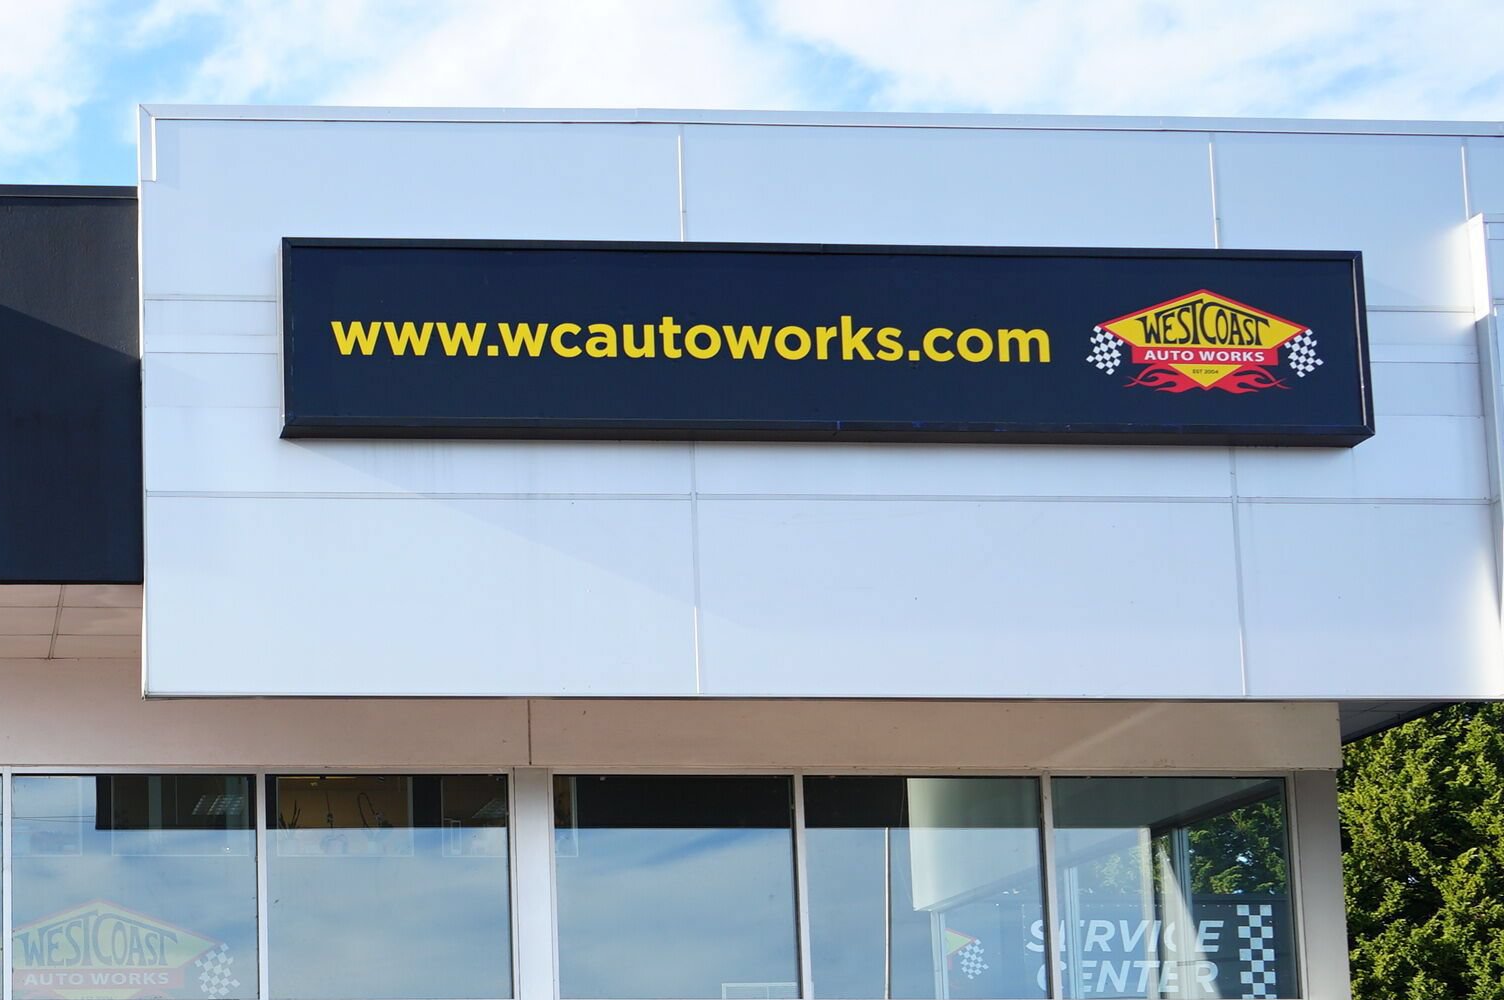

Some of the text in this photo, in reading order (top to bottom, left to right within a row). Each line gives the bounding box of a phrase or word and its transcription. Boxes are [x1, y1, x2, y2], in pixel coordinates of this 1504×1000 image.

[331, 315, 1051, 363] www.wcautoworks.com
[1144, 350, 1265, 362] AUTO WORKS
[24, 972, 169, 986] AUTO WORKS
